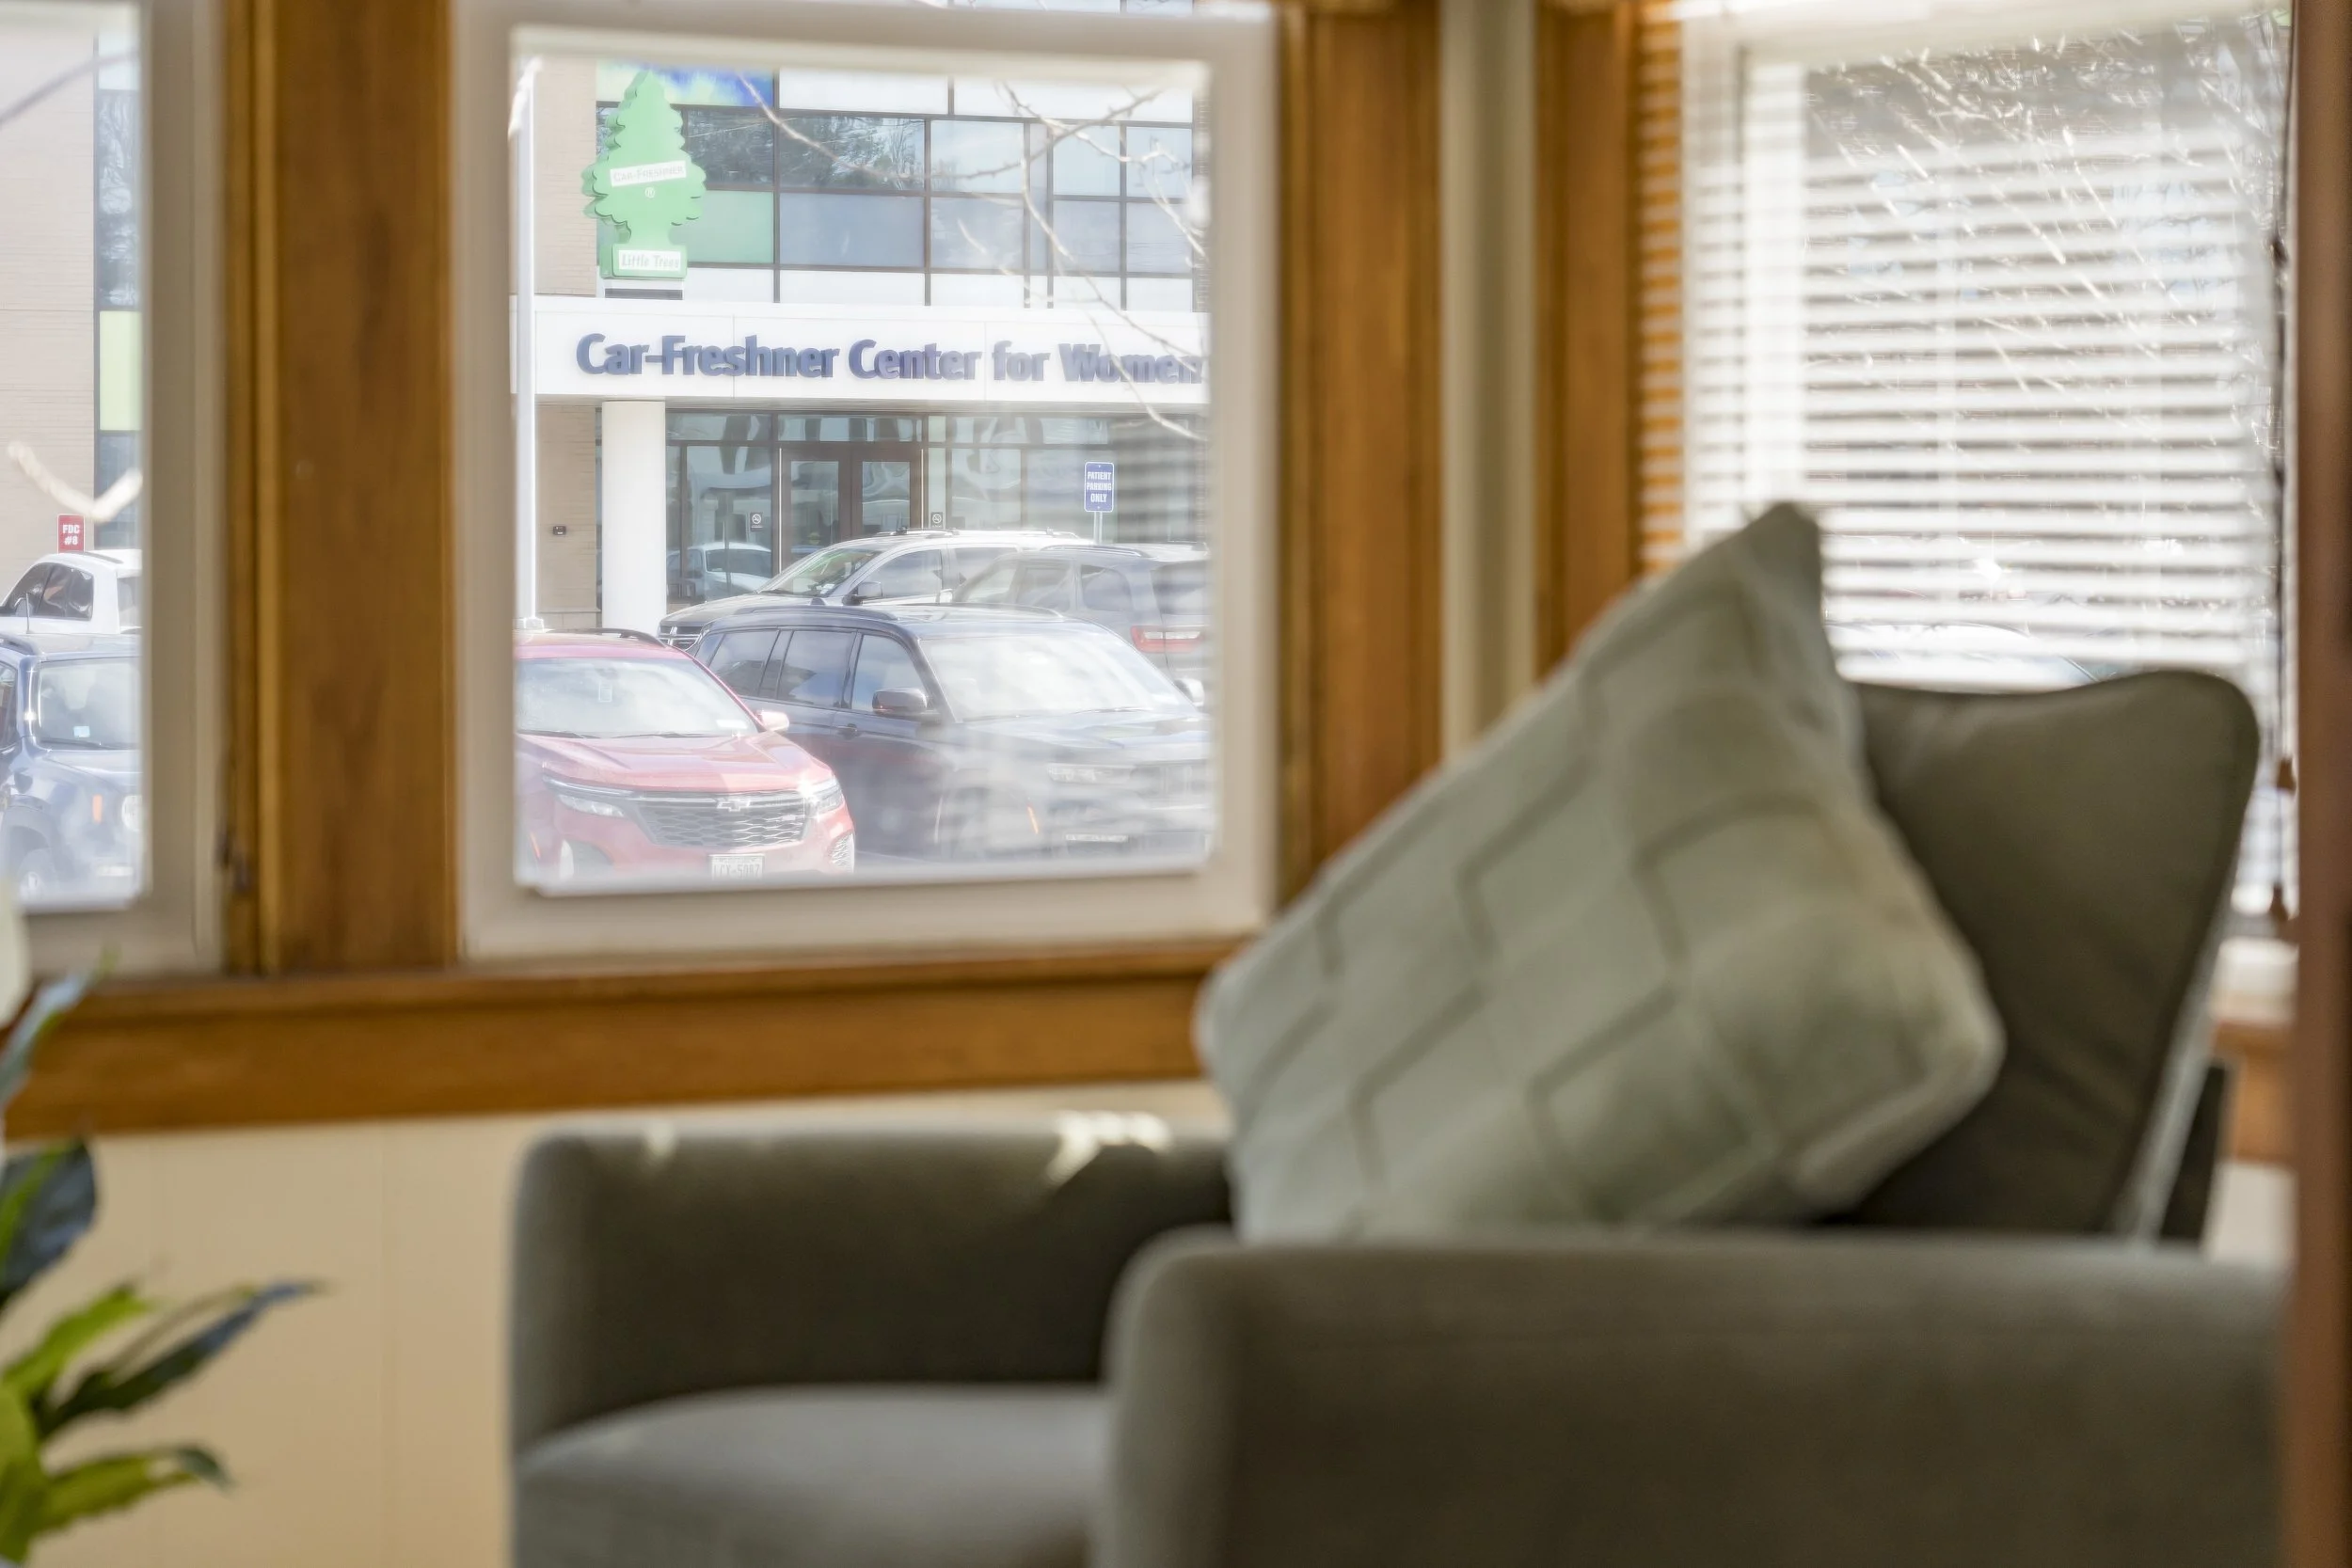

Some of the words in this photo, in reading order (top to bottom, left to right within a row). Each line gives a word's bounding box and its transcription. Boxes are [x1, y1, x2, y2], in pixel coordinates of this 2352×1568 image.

[622, 253, 649, 267] Little
[653, 254, 679, 269] Trees
[576, 332, 841, 378] Car-Freshner
[848, 339, 983, 381] Center
[992, 340, 1052, 382] for
[1057, 342, 1203, 385] Women
[1087, 471, 1112, 481] PATIENT
[1086, 482, 1112, 491] PARKING
[1090, 493, 1107, 503] ONLY
[62, 524, 80, 534] FDC
